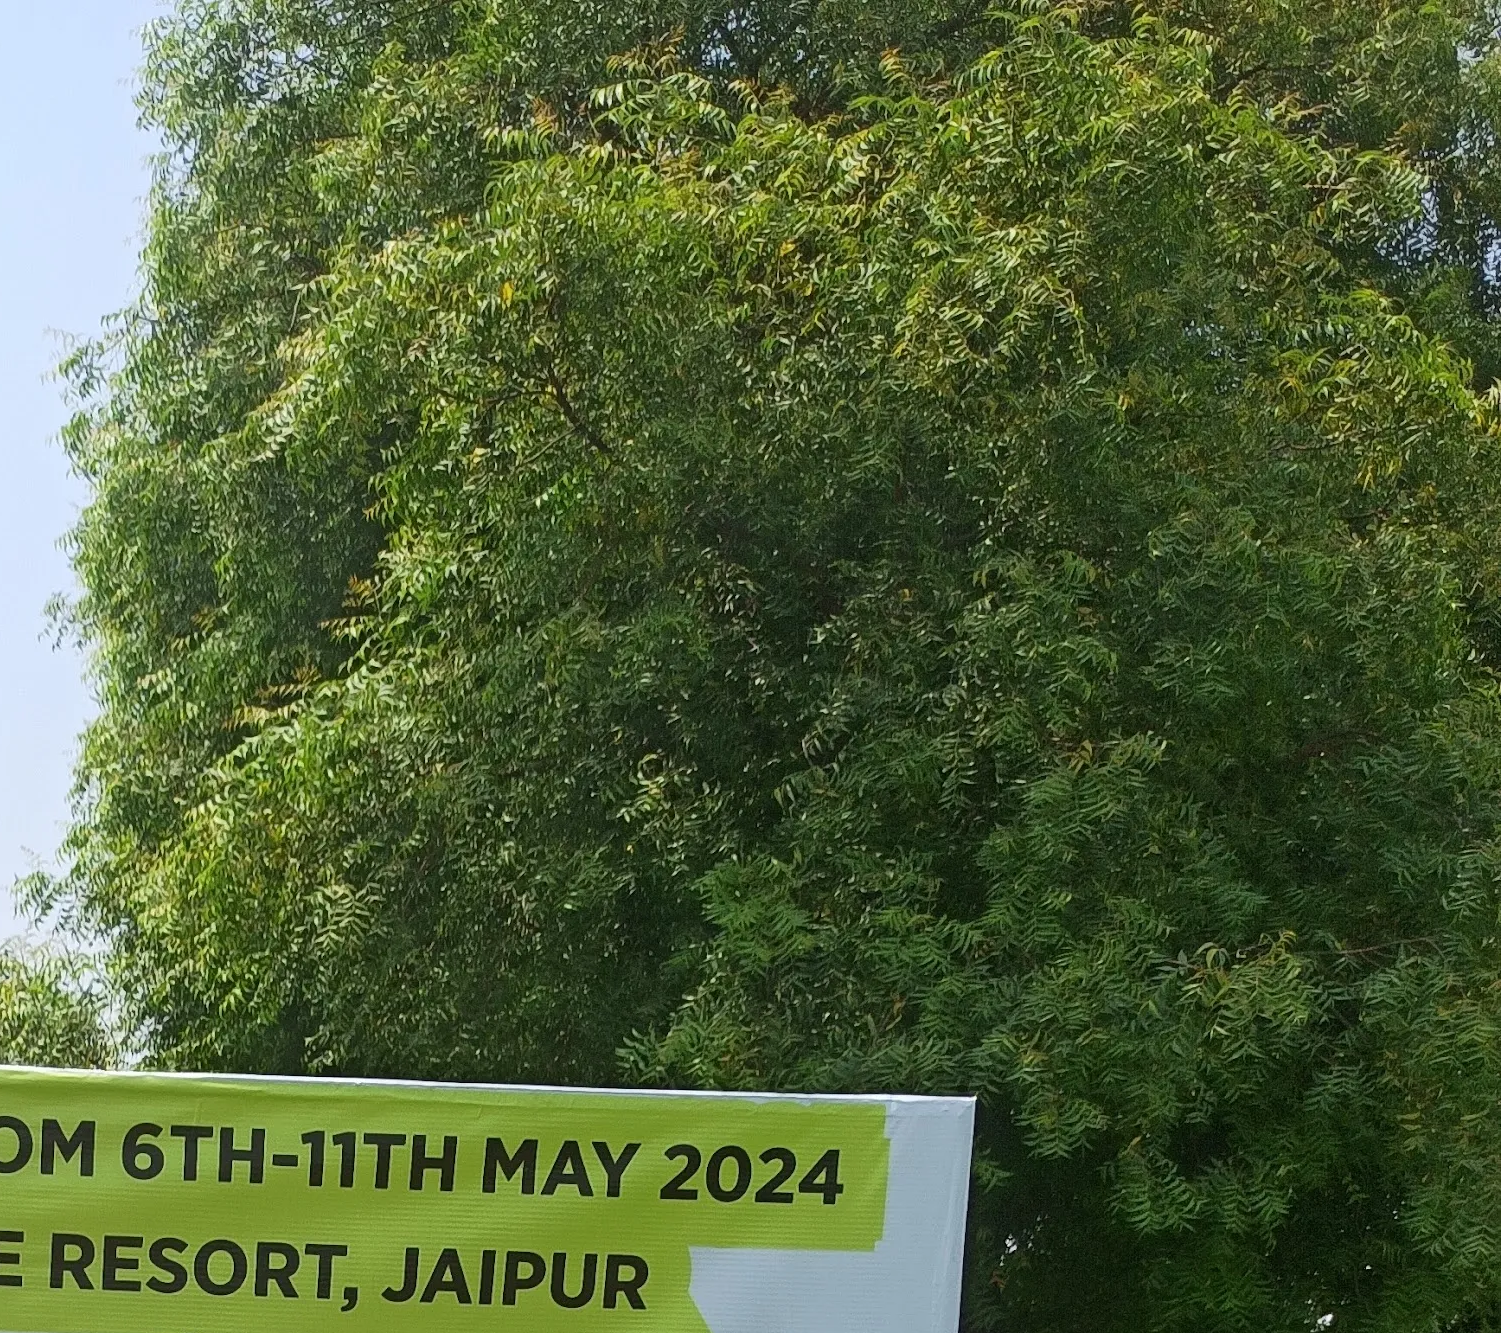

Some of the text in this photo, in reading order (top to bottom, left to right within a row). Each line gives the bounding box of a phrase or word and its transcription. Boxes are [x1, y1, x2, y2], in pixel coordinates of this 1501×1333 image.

[122, 1123, 457, 1191] 6TH-11TH
[482, 1138, 641, 1197] MAY
[660, 1144, 843, 1204] 2024
[50, 1233, 358, 1312] RESORT,
[382, 1248, 648, 1309] JAIPUR
